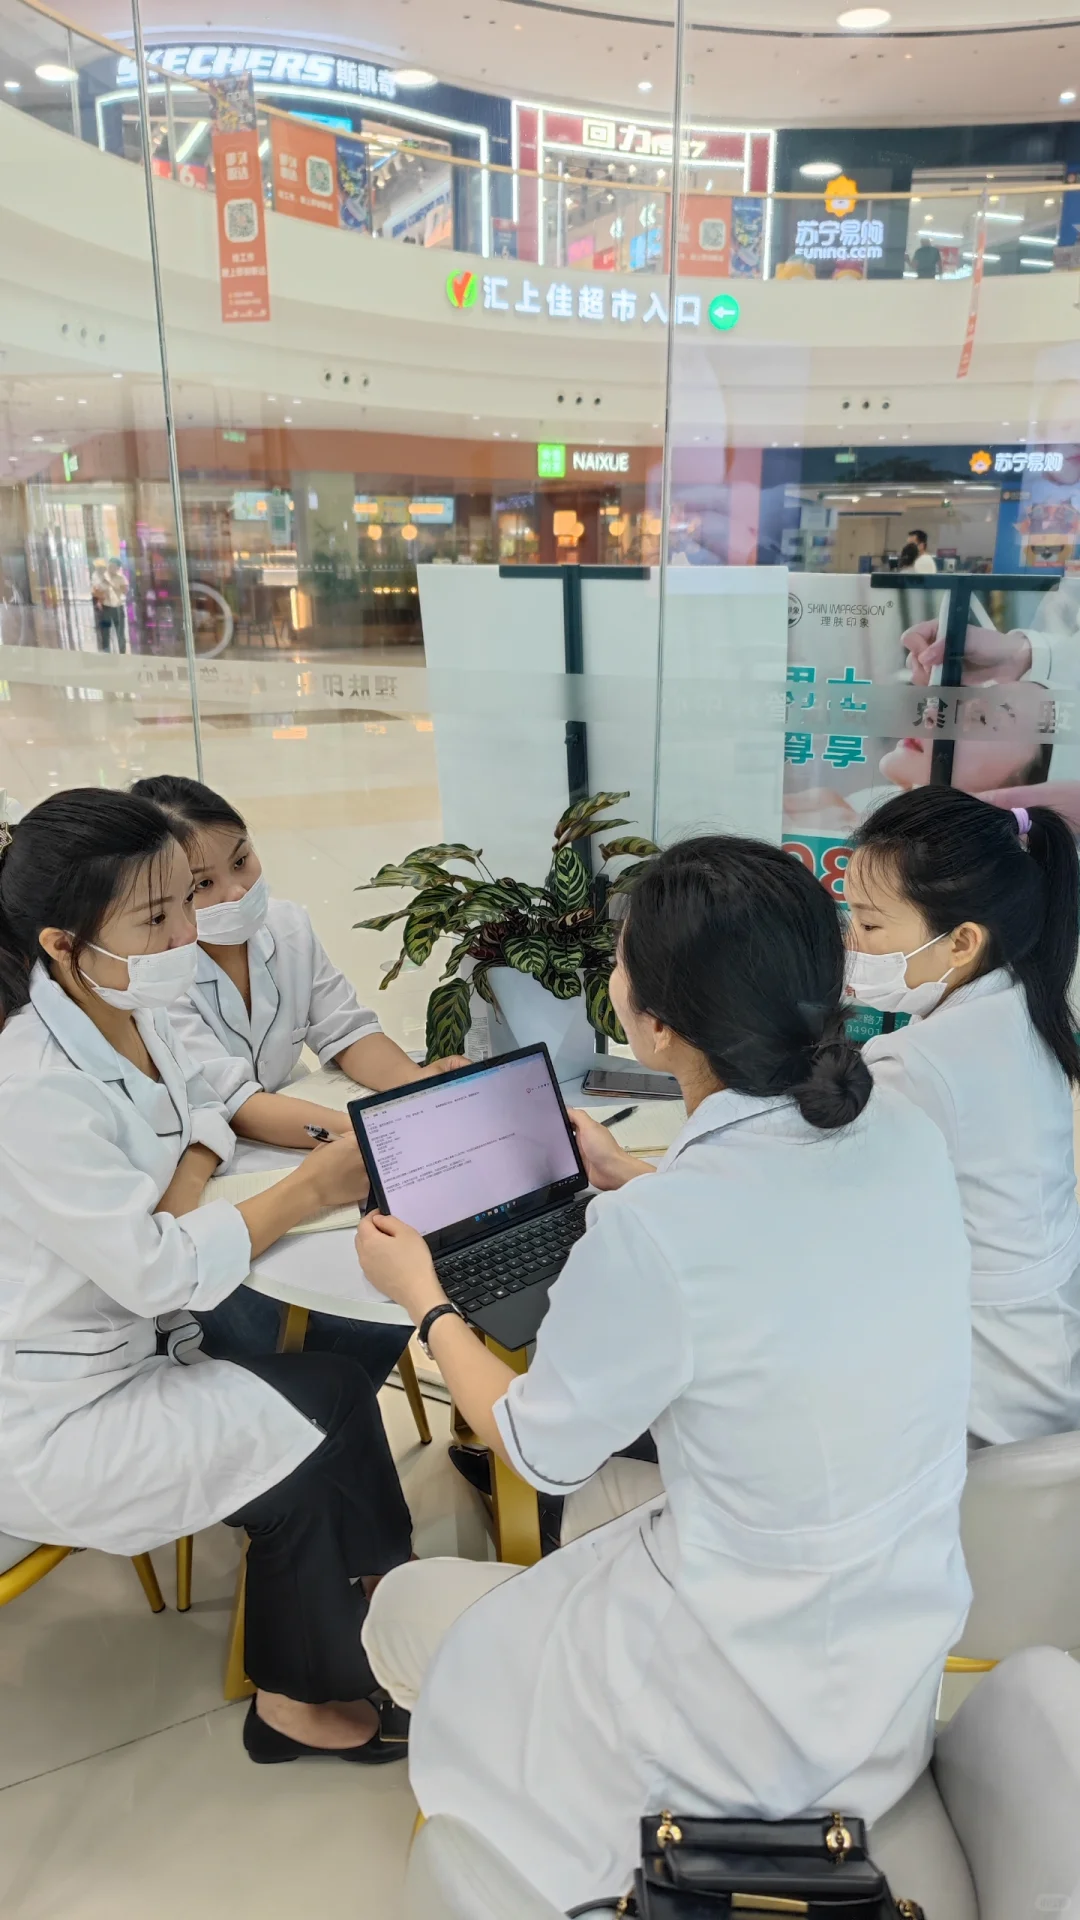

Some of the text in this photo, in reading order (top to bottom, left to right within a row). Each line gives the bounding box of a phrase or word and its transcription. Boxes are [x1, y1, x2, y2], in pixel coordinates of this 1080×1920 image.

[116, 45, 397, 99] SKECHERS 斯凯奇
[795, 218, 884, 247] 苏宁易购
[482, 275, 701, 326] 汇上佳超市入口
[572, 450, 630, 472] NAIXUE
[994, 452, 1064, 472] 苏宁易购
[807, 603, 885, 616] SKIN IMPRESSION
[820, 616, 869, 628] 理肤印象
